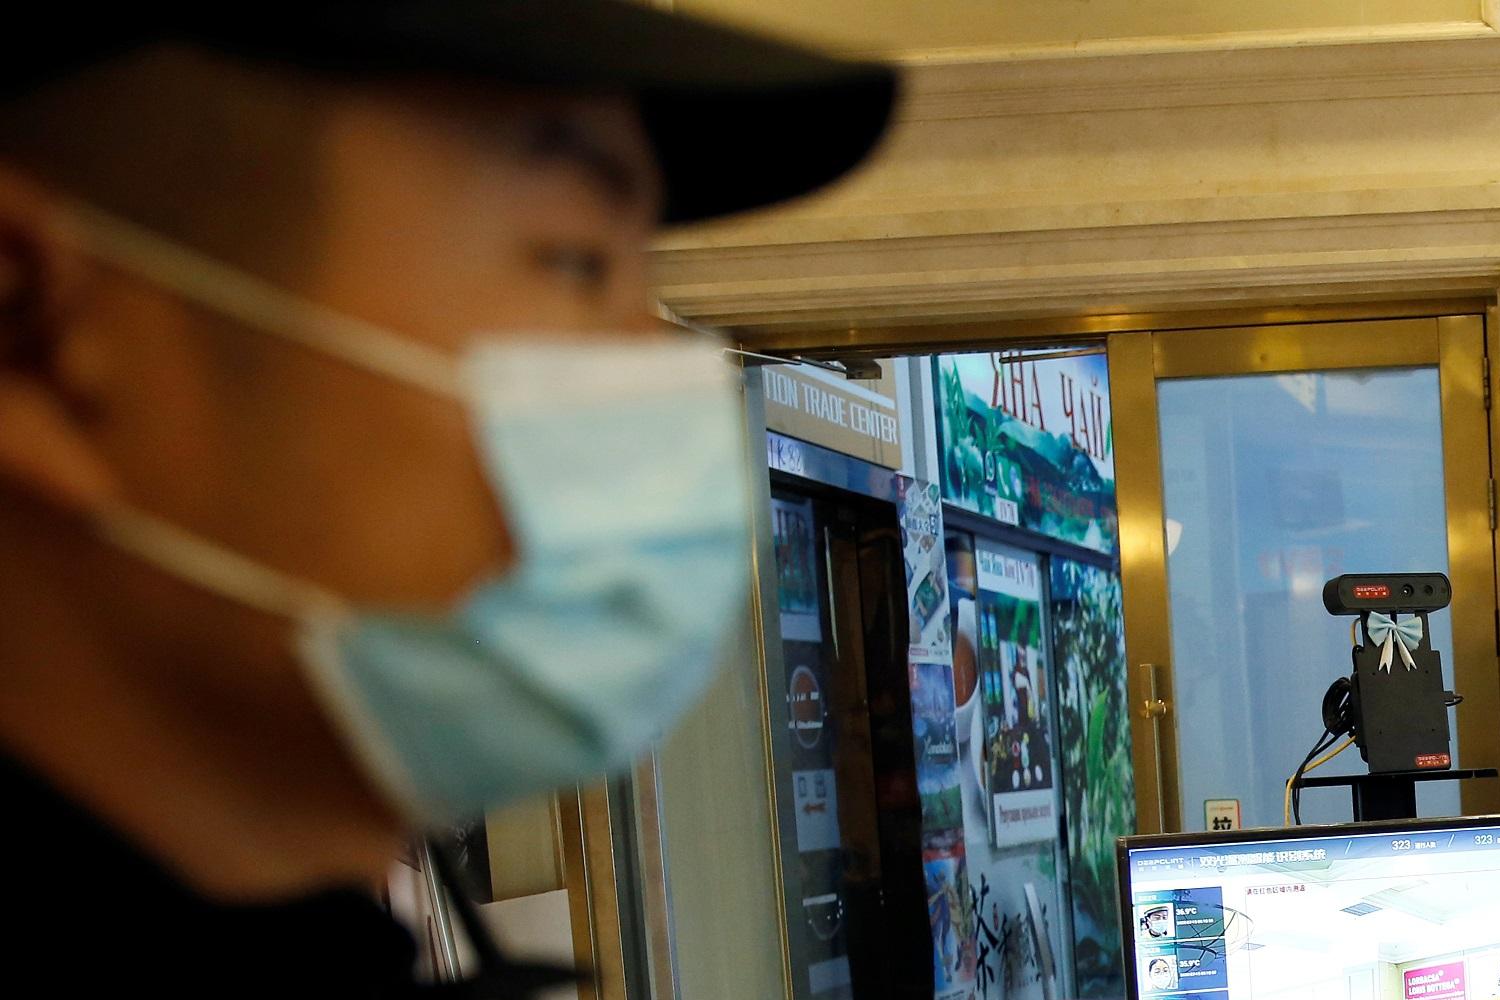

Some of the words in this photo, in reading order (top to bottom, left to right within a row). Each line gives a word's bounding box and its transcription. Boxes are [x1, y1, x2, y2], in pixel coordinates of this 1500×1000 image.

[802, 382, 848, 427] TRADE
[848, 402, 898, 445] CENTER
[1474, 834, 1493, 845] 323
[1391, 840, 1411, 851] 323
